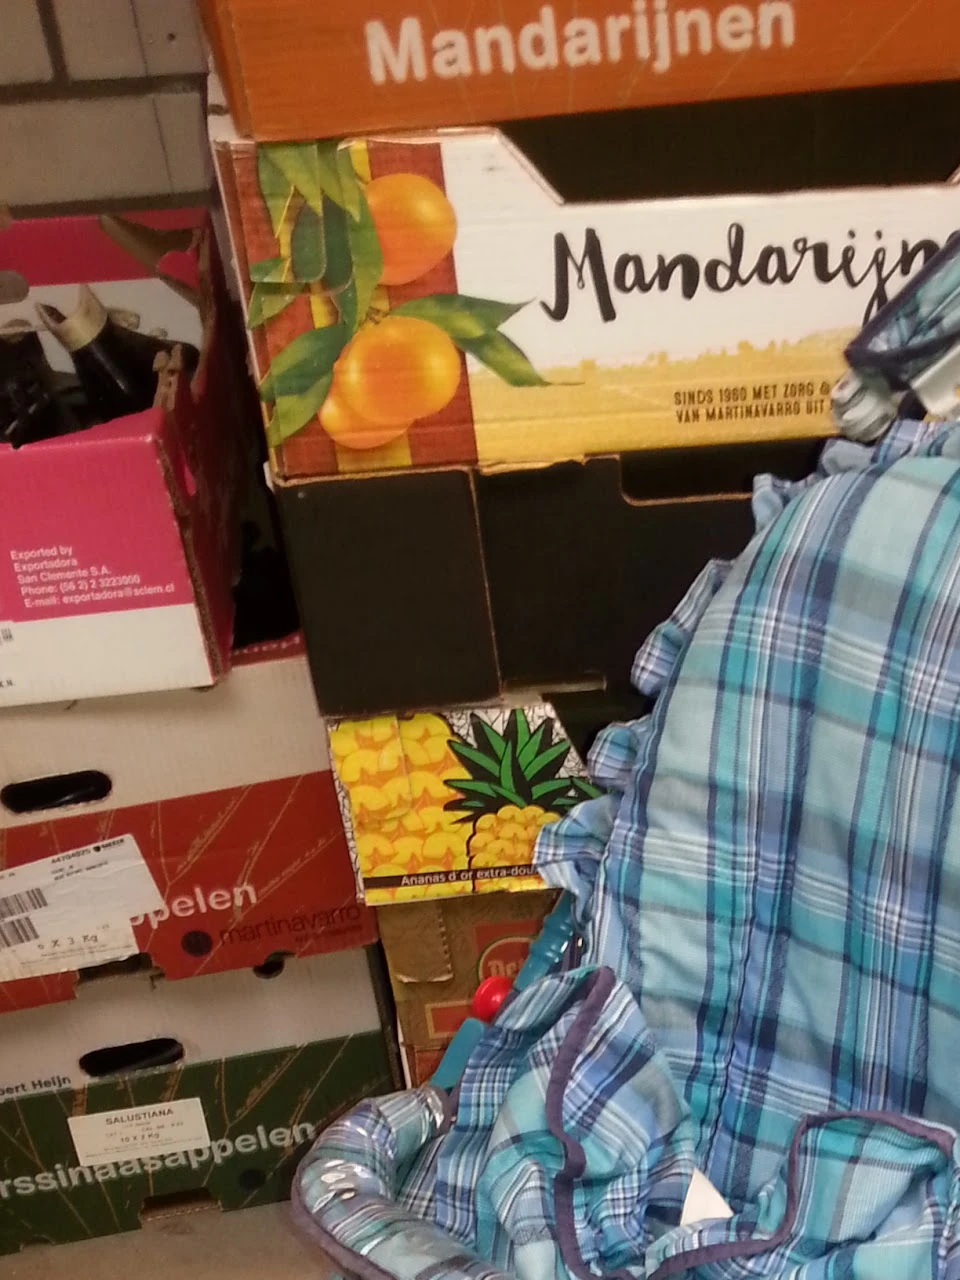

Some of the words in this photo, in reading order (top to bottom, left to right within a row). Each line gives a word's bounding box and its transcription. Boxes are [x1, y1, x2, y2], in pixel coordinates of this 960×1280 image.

[364, 0, 796, 85] Mandarijnen
[539, 222, 960, 326] Mandarijn
[674, 389, 713, 406] SINDS
[719, 386, 747, 402] 1960
[752, 384, 778, 400] MET
[783, 381, 814, 398] ZORG
[675, 409, 700, 424] VAN
[706, 401, 800, 422] MARTINAVARRO
[806, 399, 825, 415] UIT
[10, 547, 57, 561] Exported
[60, 545, 73, 557] by
[13, 558, 78, 573] Exportadora
[17, 574, 38, 584] San
[40, 569, 88, 583] Clemente
[90, 565, 112, 576] S.A.
[21, 584, 58, 597] Phone:
[24, 596, 61, 609] E-mail:
[401, 871, 446, 887] Ananas
[476, 865, 539, 880] extra-dou
[219, 904, 361, 946] martinavarro
[31, 1074, 72, 1090] Heijn
[105, 1108, 174, 1125] SALUSTIANA
